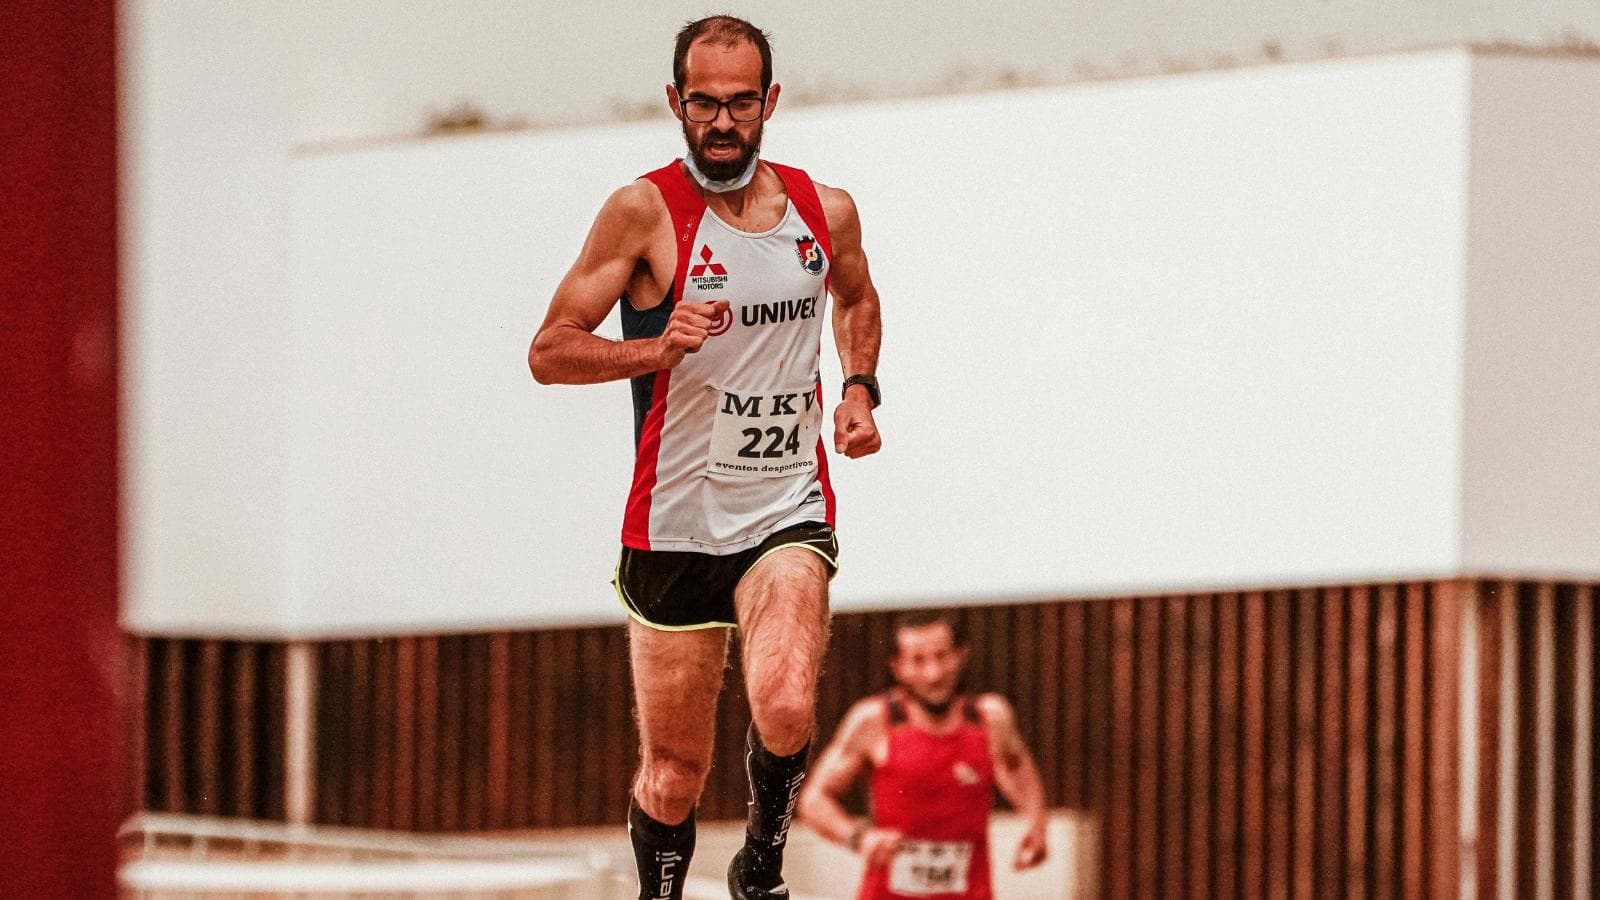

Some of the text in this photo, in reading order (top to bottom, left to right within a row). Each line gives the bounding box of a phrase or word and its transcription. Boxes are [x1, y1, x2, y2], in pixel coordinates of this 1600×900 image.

[741, 296, 817, 327] UNIVEX
[738, 423, 800, 458] 224
[715, 460, 814, 473] eventos desportivos
